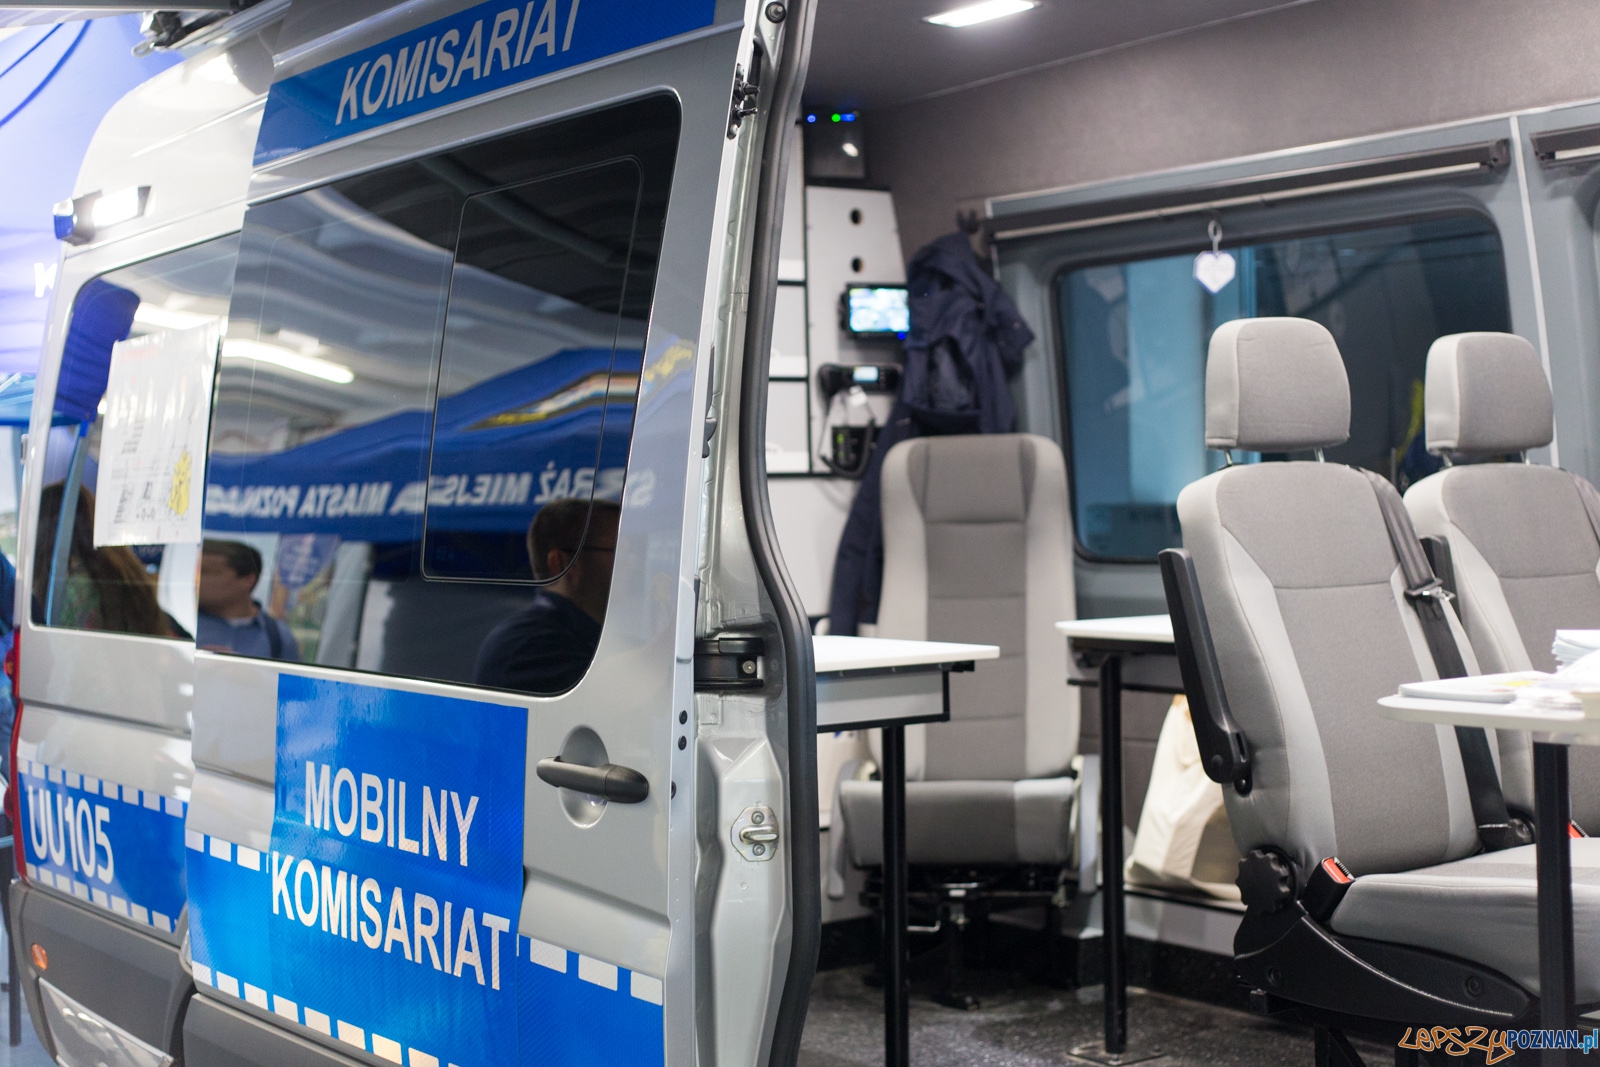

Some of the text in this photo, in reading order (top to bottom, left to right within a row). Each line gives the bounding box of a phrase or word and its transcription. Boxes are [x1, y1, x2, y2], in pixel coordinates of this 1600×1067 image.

[28, 785, 114, 885] UU105
[304, 760, 480, 868] MOBILNY
[271, 850, 511, 991] KOMISARIAT
